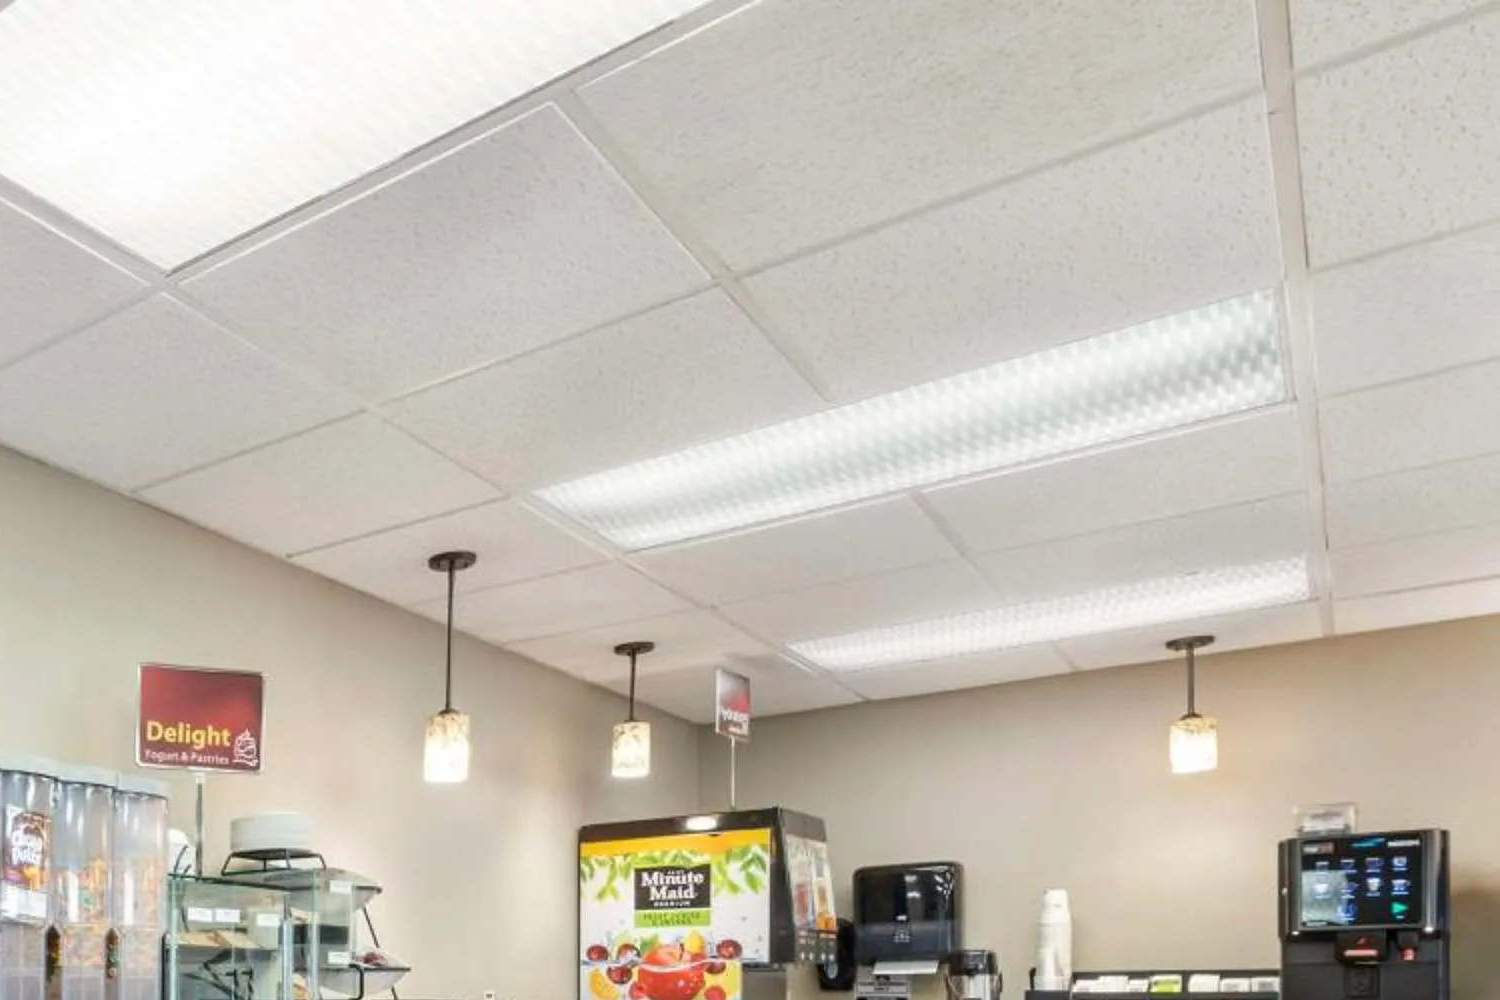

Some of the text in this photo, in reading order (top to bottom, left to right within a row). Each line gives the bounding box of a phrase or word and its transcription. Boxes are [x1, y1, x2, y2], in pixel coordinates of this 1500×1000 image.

[146, 720, 231, 750] Delight
[641, 871, 704, 887] Minute
[649, 883, 698, 901] Maid
